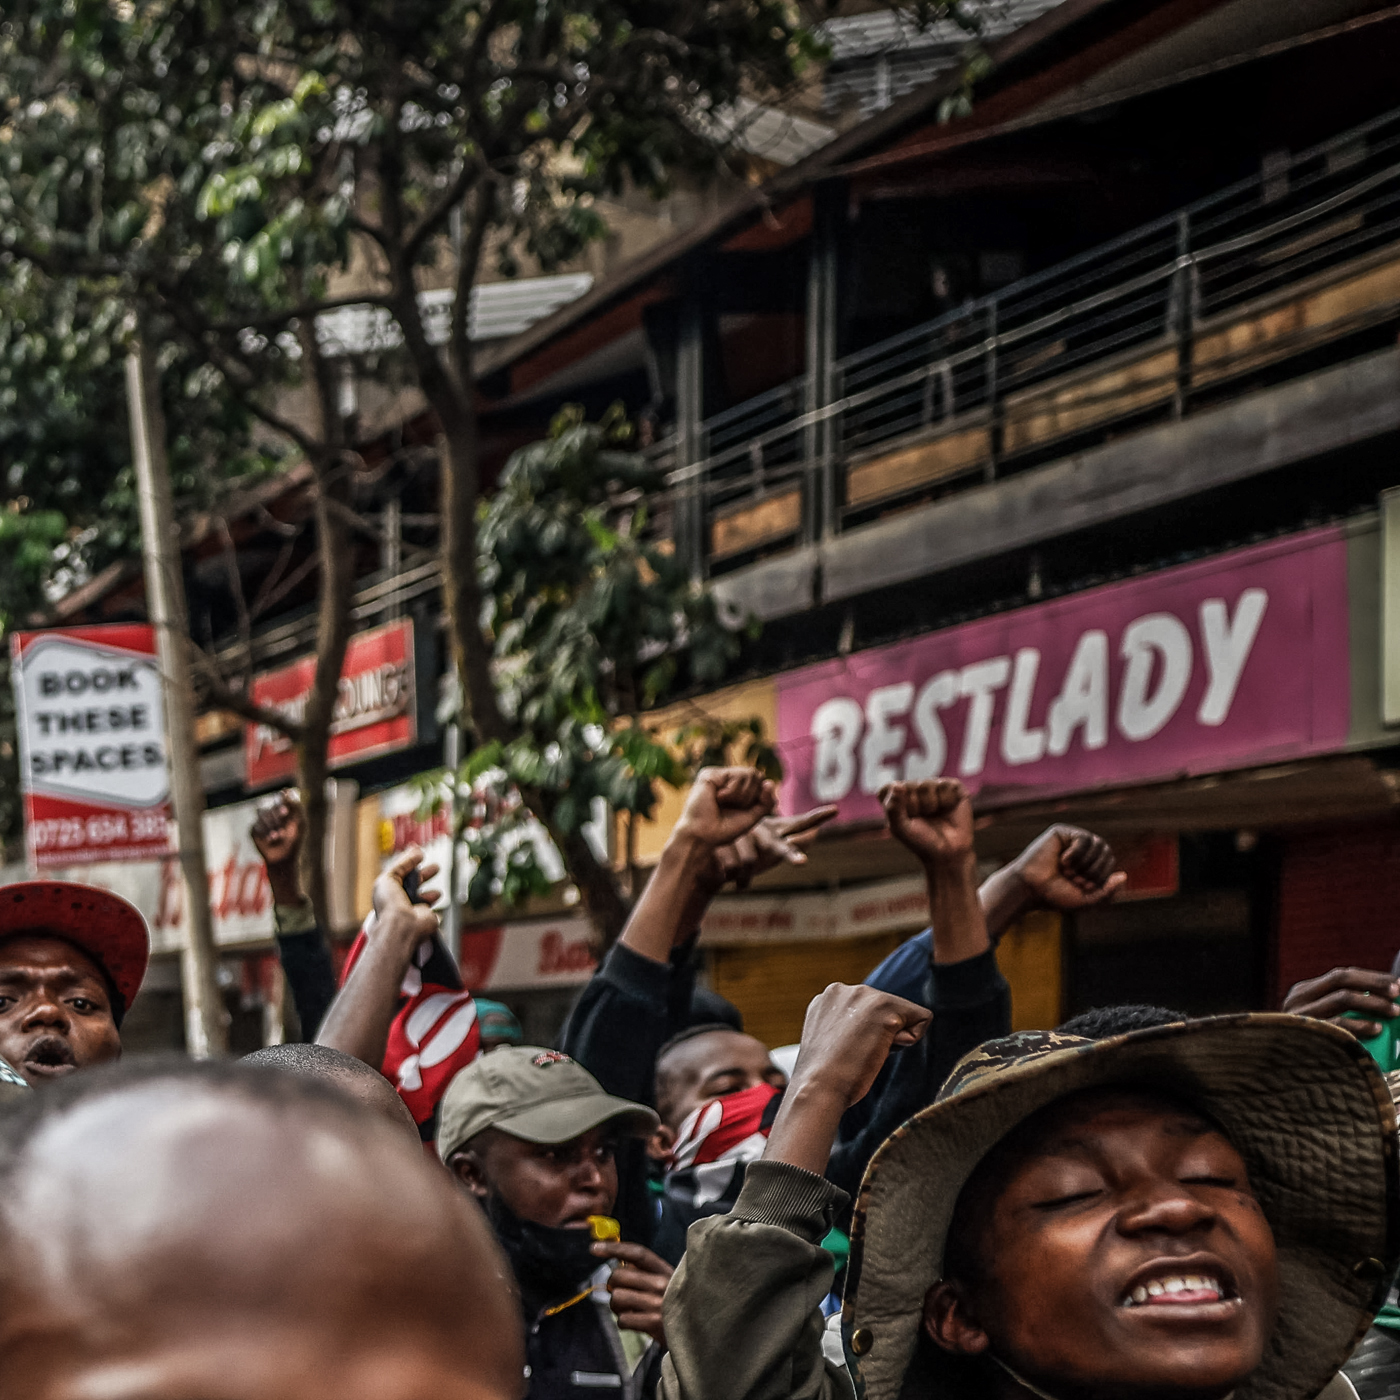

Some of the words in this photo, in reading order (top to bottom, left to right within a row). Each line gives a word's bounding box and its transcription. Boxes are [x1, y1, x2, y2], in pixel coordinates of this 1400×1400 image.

[39, 668, 139, 698] BOOK
[810, 586, 1269, 802] BESTLADY
[35, 704, 147, 734] THESE
[31, 743, 163, 774] SPACES
